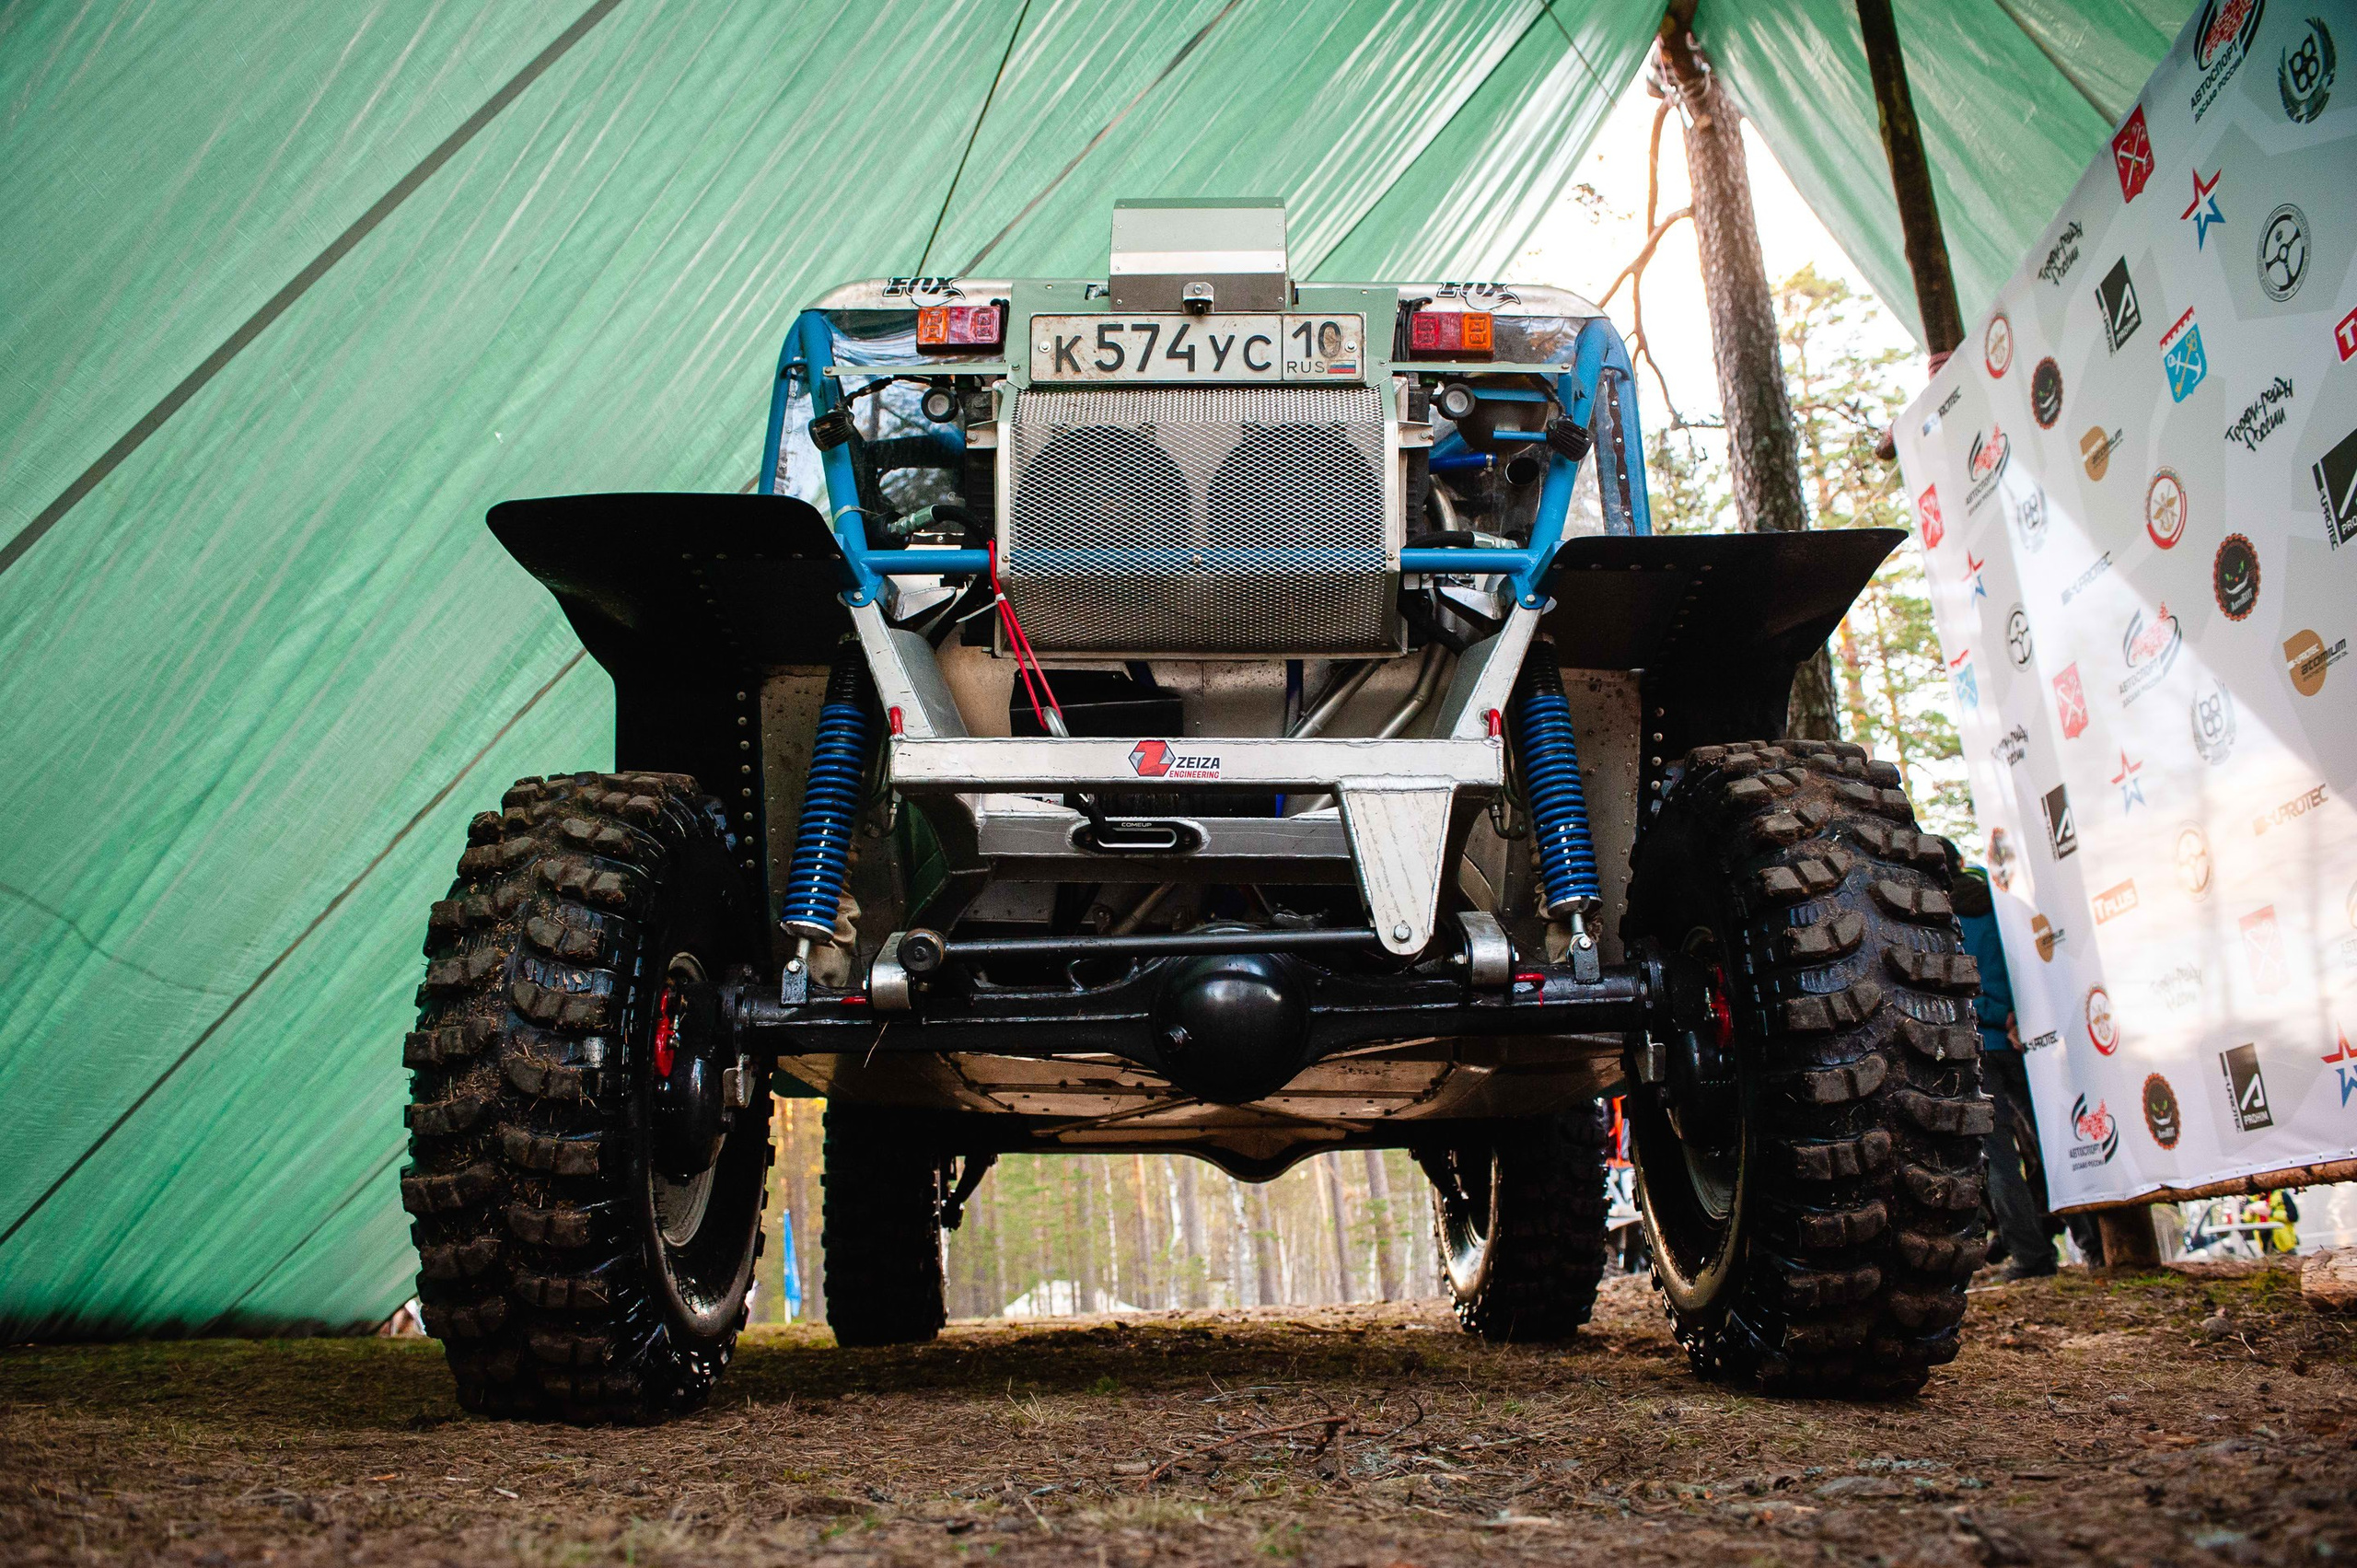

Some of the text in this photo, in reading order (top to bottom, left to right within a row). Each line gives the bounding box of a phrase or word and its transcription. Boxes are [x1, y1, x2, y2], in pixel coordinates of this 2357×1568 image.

[2190, 39, 2239, 110] АВТОСПОРТ
[2217, 55, 2243, 91] РОССИИ
[882, 276, 964, 303] FOX
[1436, 282, 1518, 306] FOX
[1292, 320, 1342, 359] 10
[1286, 360, 1325, 374] RUS
[1168, 770, 1220, 779] ENGINEERING
[1176, 756, 1220, 769] ZEIZA
[2244, 1109, 2270, 1126] PROHIM
